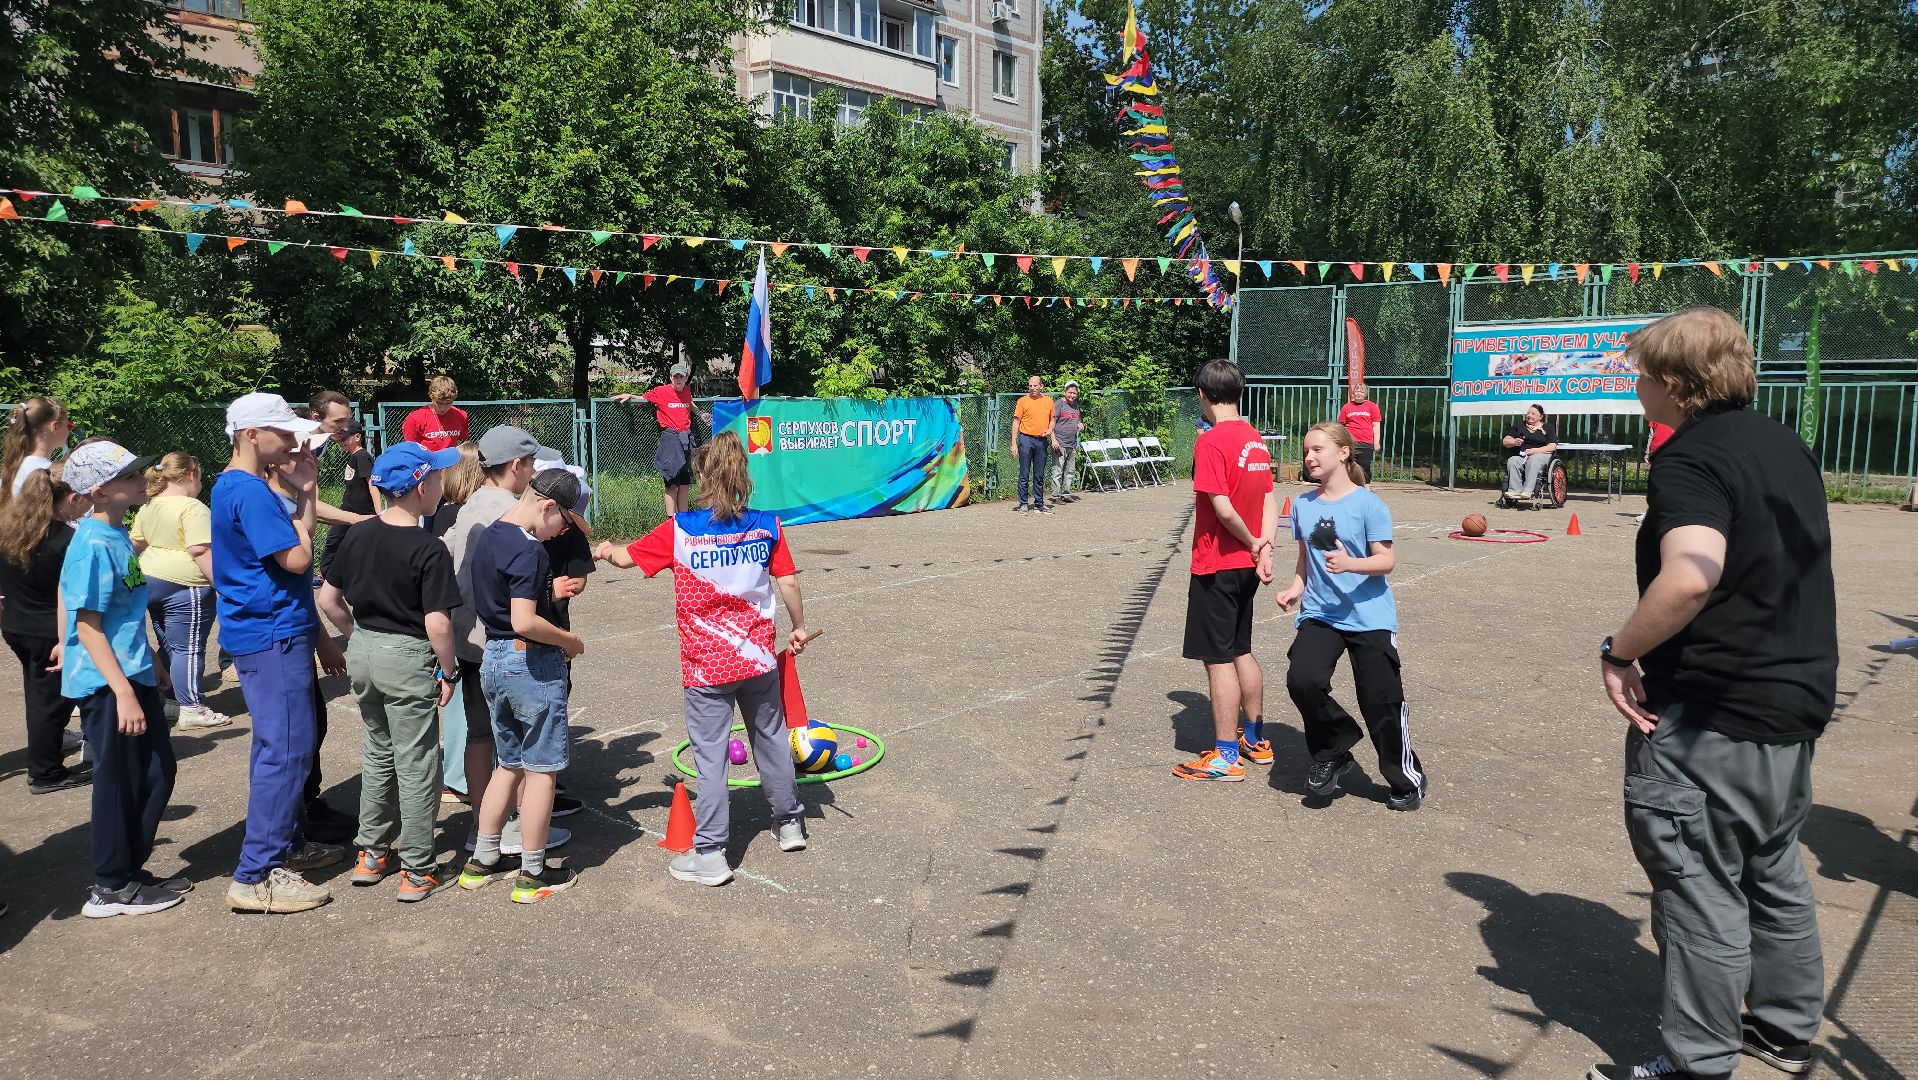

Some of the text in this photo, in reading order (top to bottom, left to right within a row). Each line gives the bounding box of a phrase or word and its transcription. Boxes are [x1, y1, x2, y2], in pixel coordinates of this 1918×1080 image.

[1453, 332, 1630, 353] ПРИВЕТСТВУЕМ УЧА
[1453, 376, 1639, 396] СПОРТИВНЫХ СОРЕВН
[778, 420, 840, 436] СЕРПУХОВ
[841, 418, 917, 447] СПОРТ
[779, 435, 840, 451] ВЫБИРАЕТ
[690, 541, 770, 569] СЕРПУХОВ
